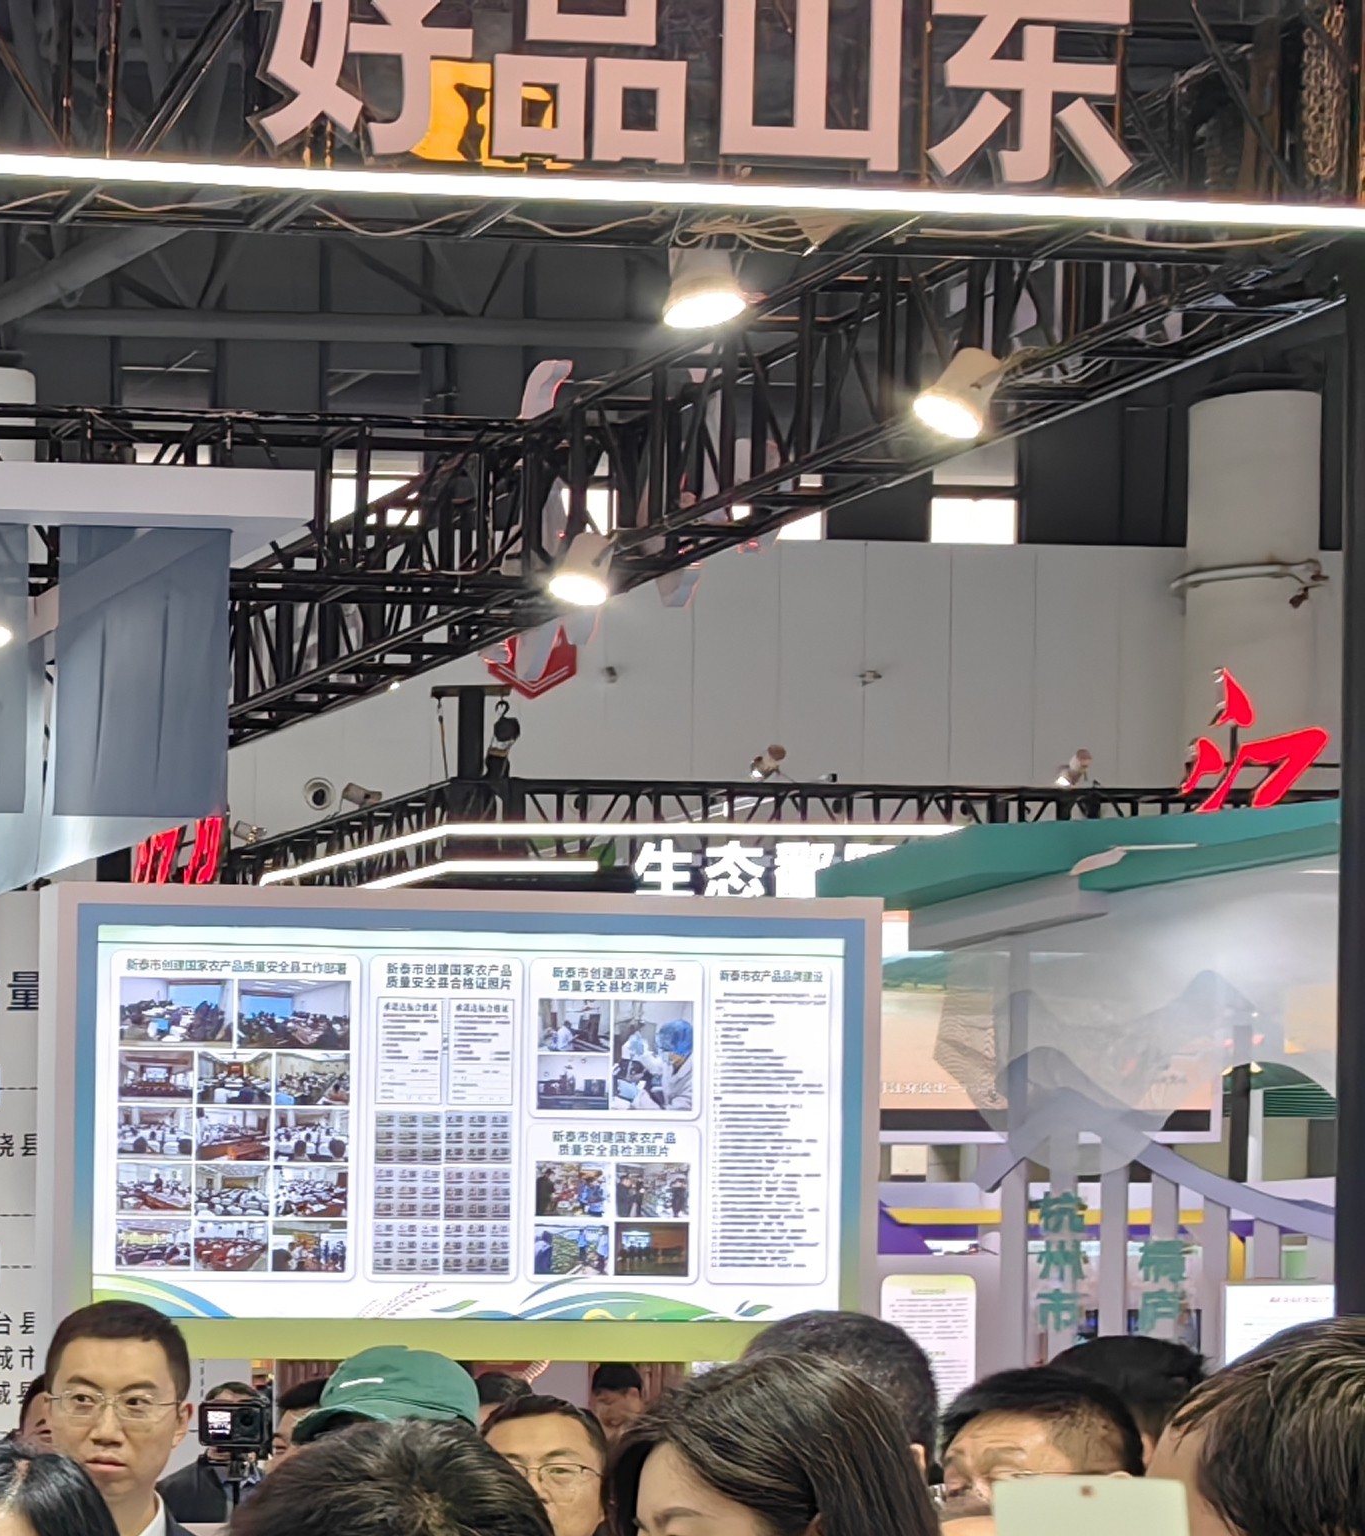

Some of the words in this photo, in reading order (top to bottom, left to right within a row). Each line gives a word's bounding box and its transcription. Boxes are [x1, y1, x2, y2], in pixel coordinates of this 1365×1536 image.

[259, 0, 1135, 190] 好品山东
[386, 962, 513, 977] 新泰市创建国家农产品
[552, 966, 676, 981] 新泰市创建国家农产品
